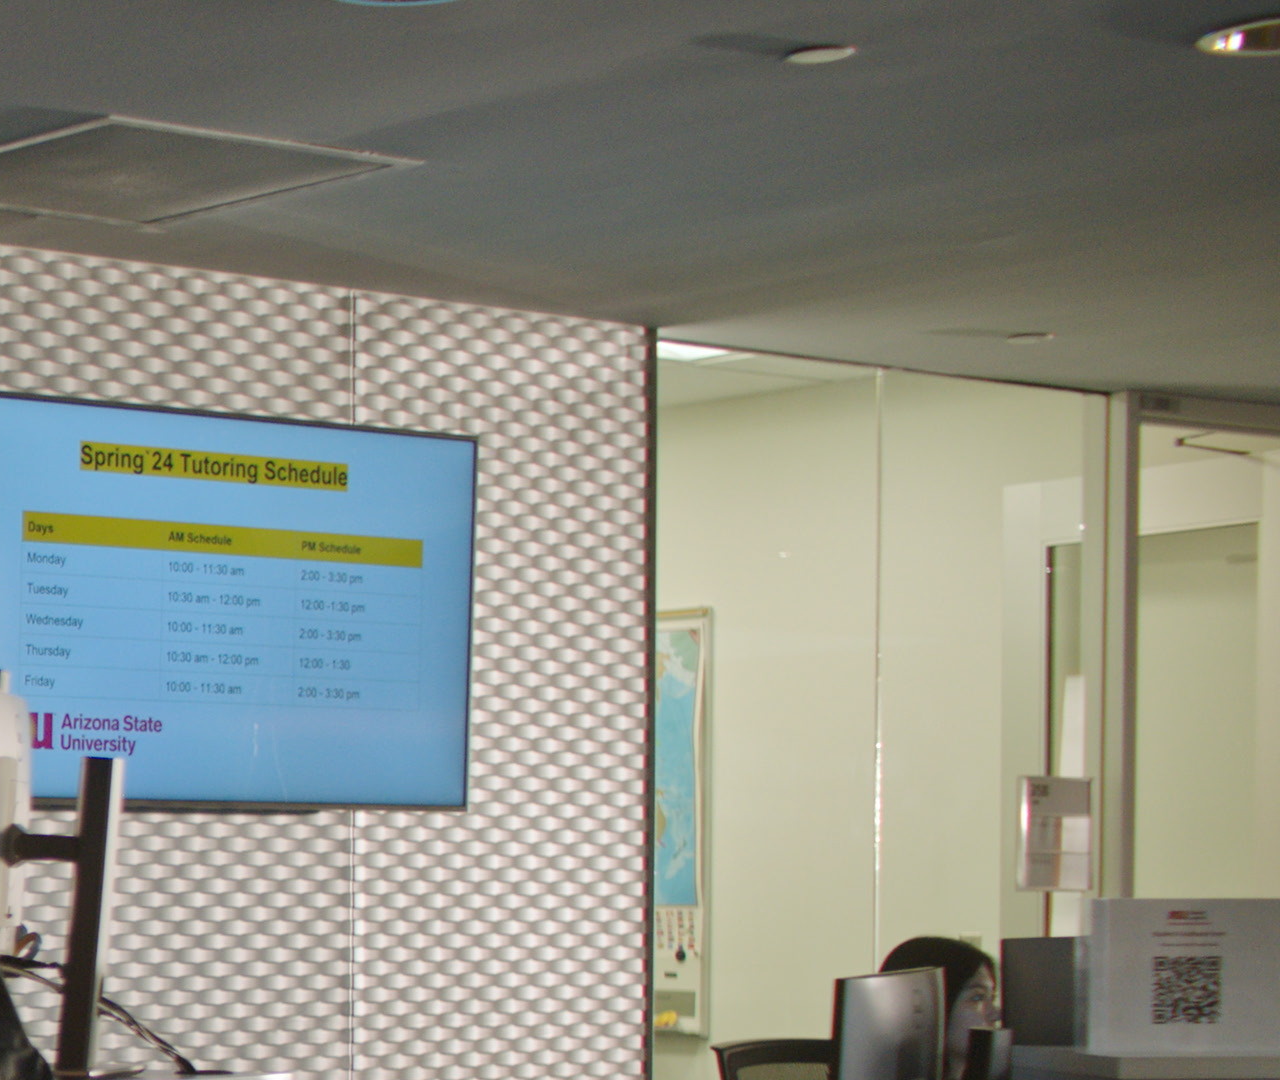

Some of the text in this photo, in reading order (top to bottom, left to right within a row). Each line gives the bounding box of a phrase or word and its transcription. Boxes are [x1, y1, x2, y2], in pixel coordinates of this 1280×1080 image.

[181, 453, 258, 484] Tutoring
[264, 460, 348, 486] Schedule
[28, 521, 54, 536] Days
[168, 531, 232, 546] AM Schedule
[302, 541, 361, 554] PM Schedule
[27, 552, 66, 567] Monday
[168, 562, 193, 573] 10:00
[203, 564, 228, 575] 11:30
[230, 567, 244, 576] am
[301, 570, 320, 581] 2:00
[328, 571, 346, 583] 3:30
[349, 575, 363, 585] pm
[27, 582, 69, 598] Tuesday
[168, 592, 193, 603] 10:30
[195, 595, 209, 604] am
[219, 595, 244, 606] 12:00
[246, 598, 260, 608] pm
[301, 600, 324, 610] 12:00
[351, 604, 365, 615] pm
[26, 613, 83, 629] Wednesday
[168, 622, 192, 633] 10:00
[202, 624, 226, 634] 11:30
[229, 627, 243, 635] am
[299, 629, 318, 639] 2:00
[327, 630, 346, 641] 3:30
[348, 633, 361, 643] pm
[26, 644, 71, 660] Thursday
[167, 651, 191, 663] 10:30
[194, 654, 208, 663] am
[218, 654, 242, 665] 12:00
[245, 657, 259, 667] pm
[299, 658, 323, 669] 12:00
[332, 660, 350, 670] 1:30
[25, 675, 55, 689] Friday
[166, 681, 191, 692] 10:00
[201, 683, 225, 694] 11:30
[227, 686, 241, 695] am
[298, 687, 317, 697] 2:00
[326, 688, 344, 699] 3:30
[346, 691, 360, 701] pm
[61, 713, 119, 731] Arizona
[123, 715, 162, 732] State
[61, 734, 136, 756] University
